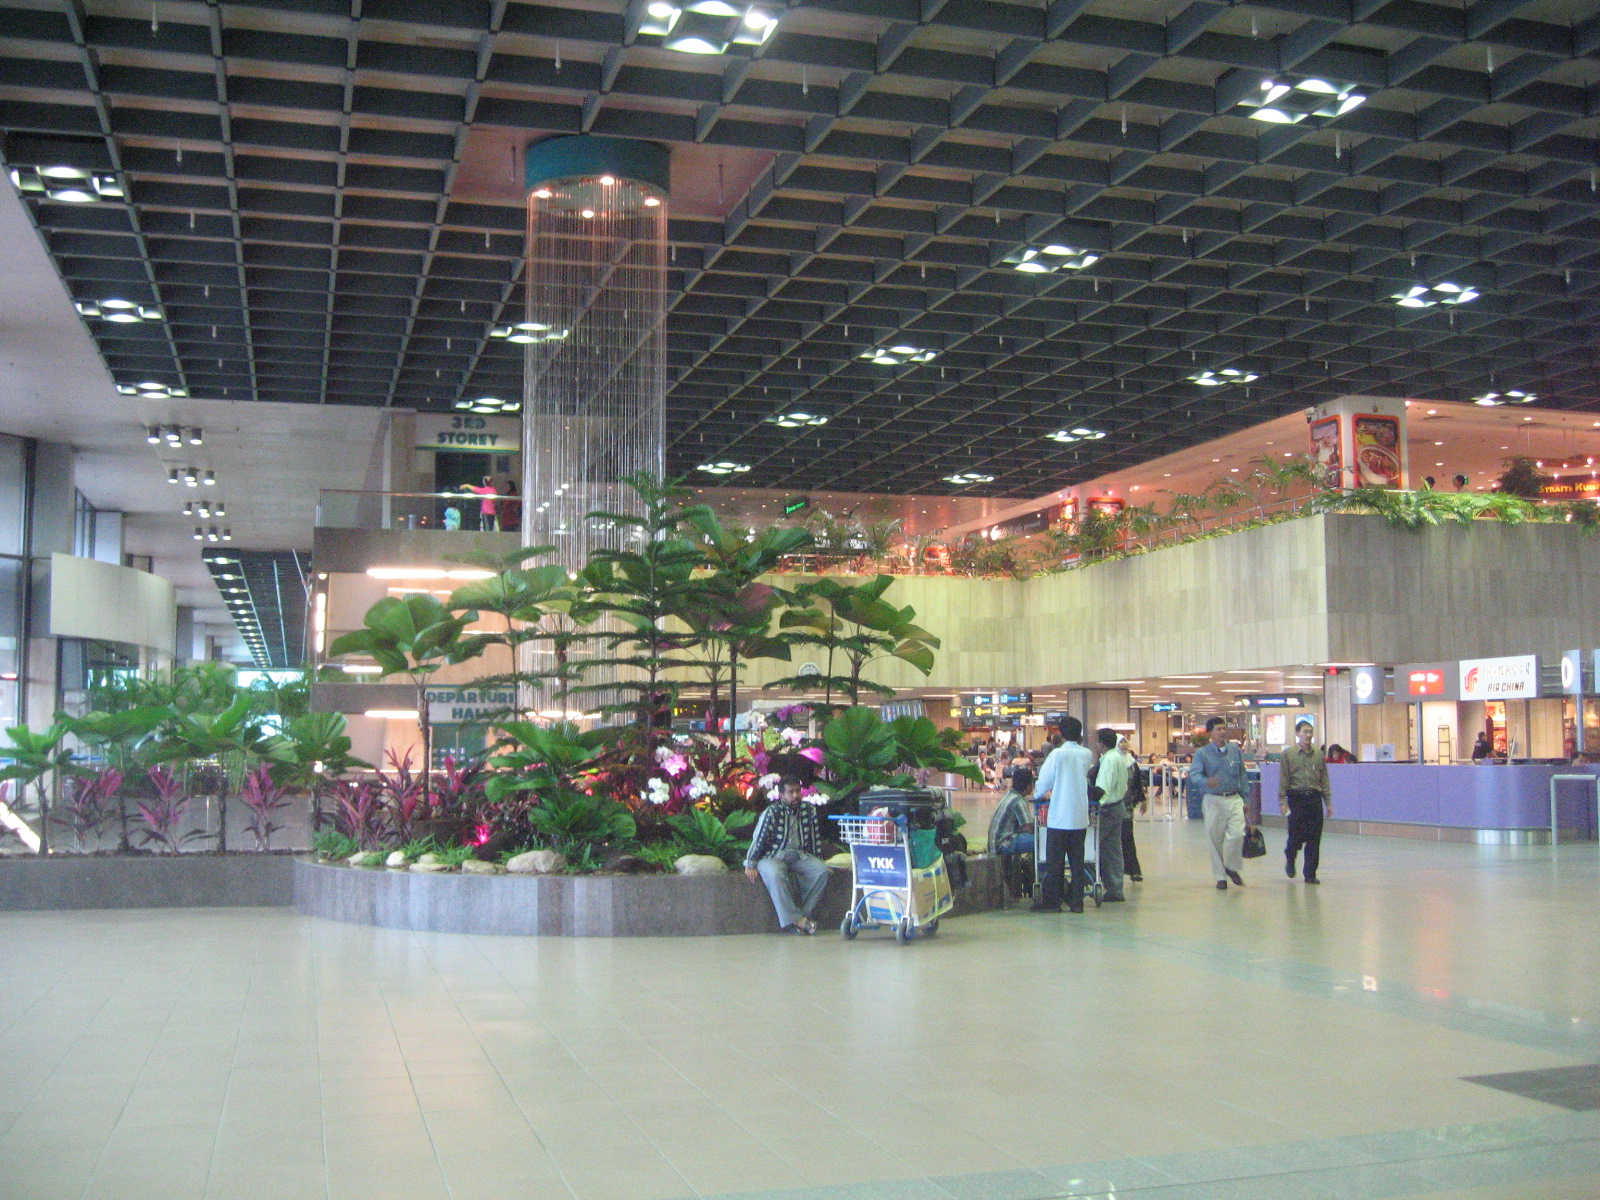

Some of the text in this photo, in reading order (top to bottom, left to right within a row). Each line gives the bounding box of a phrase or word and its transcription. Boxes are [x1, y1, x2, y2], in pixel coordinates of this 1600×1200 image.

[451, 416, 486, 429] 3RD
[438, 432, 498, 446] STOREY
[1356, 672, 1373, 699] 9
[1487, 681, 1525, 693] AIR CHINA
[867, 856, 895, 870] YKK
